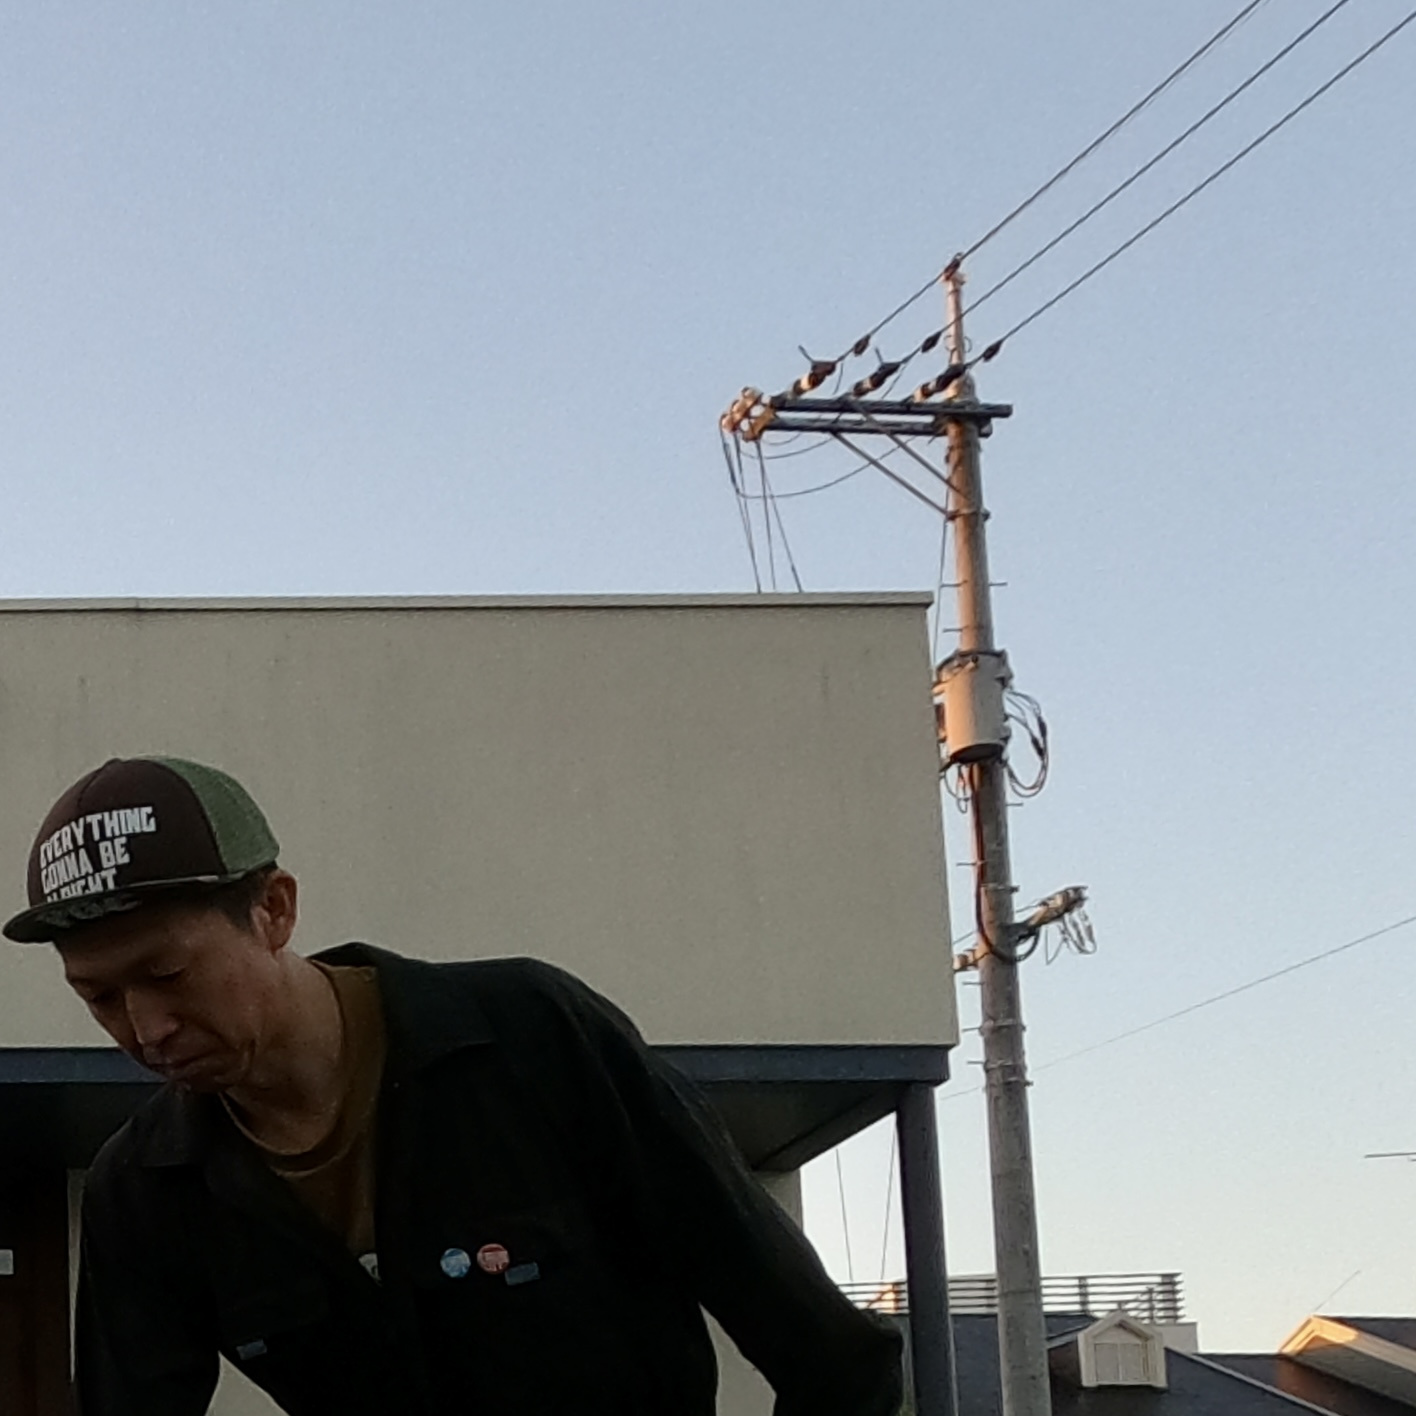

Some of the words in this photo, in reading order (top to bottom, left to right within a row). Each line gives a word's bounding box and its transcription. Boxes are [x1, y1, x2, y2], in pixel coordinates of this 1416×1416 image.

[40, 806, 156, 868] EVERYTHING
[41, 848, 94, 894] GONNA
[99, 836, 131, 869] BE
